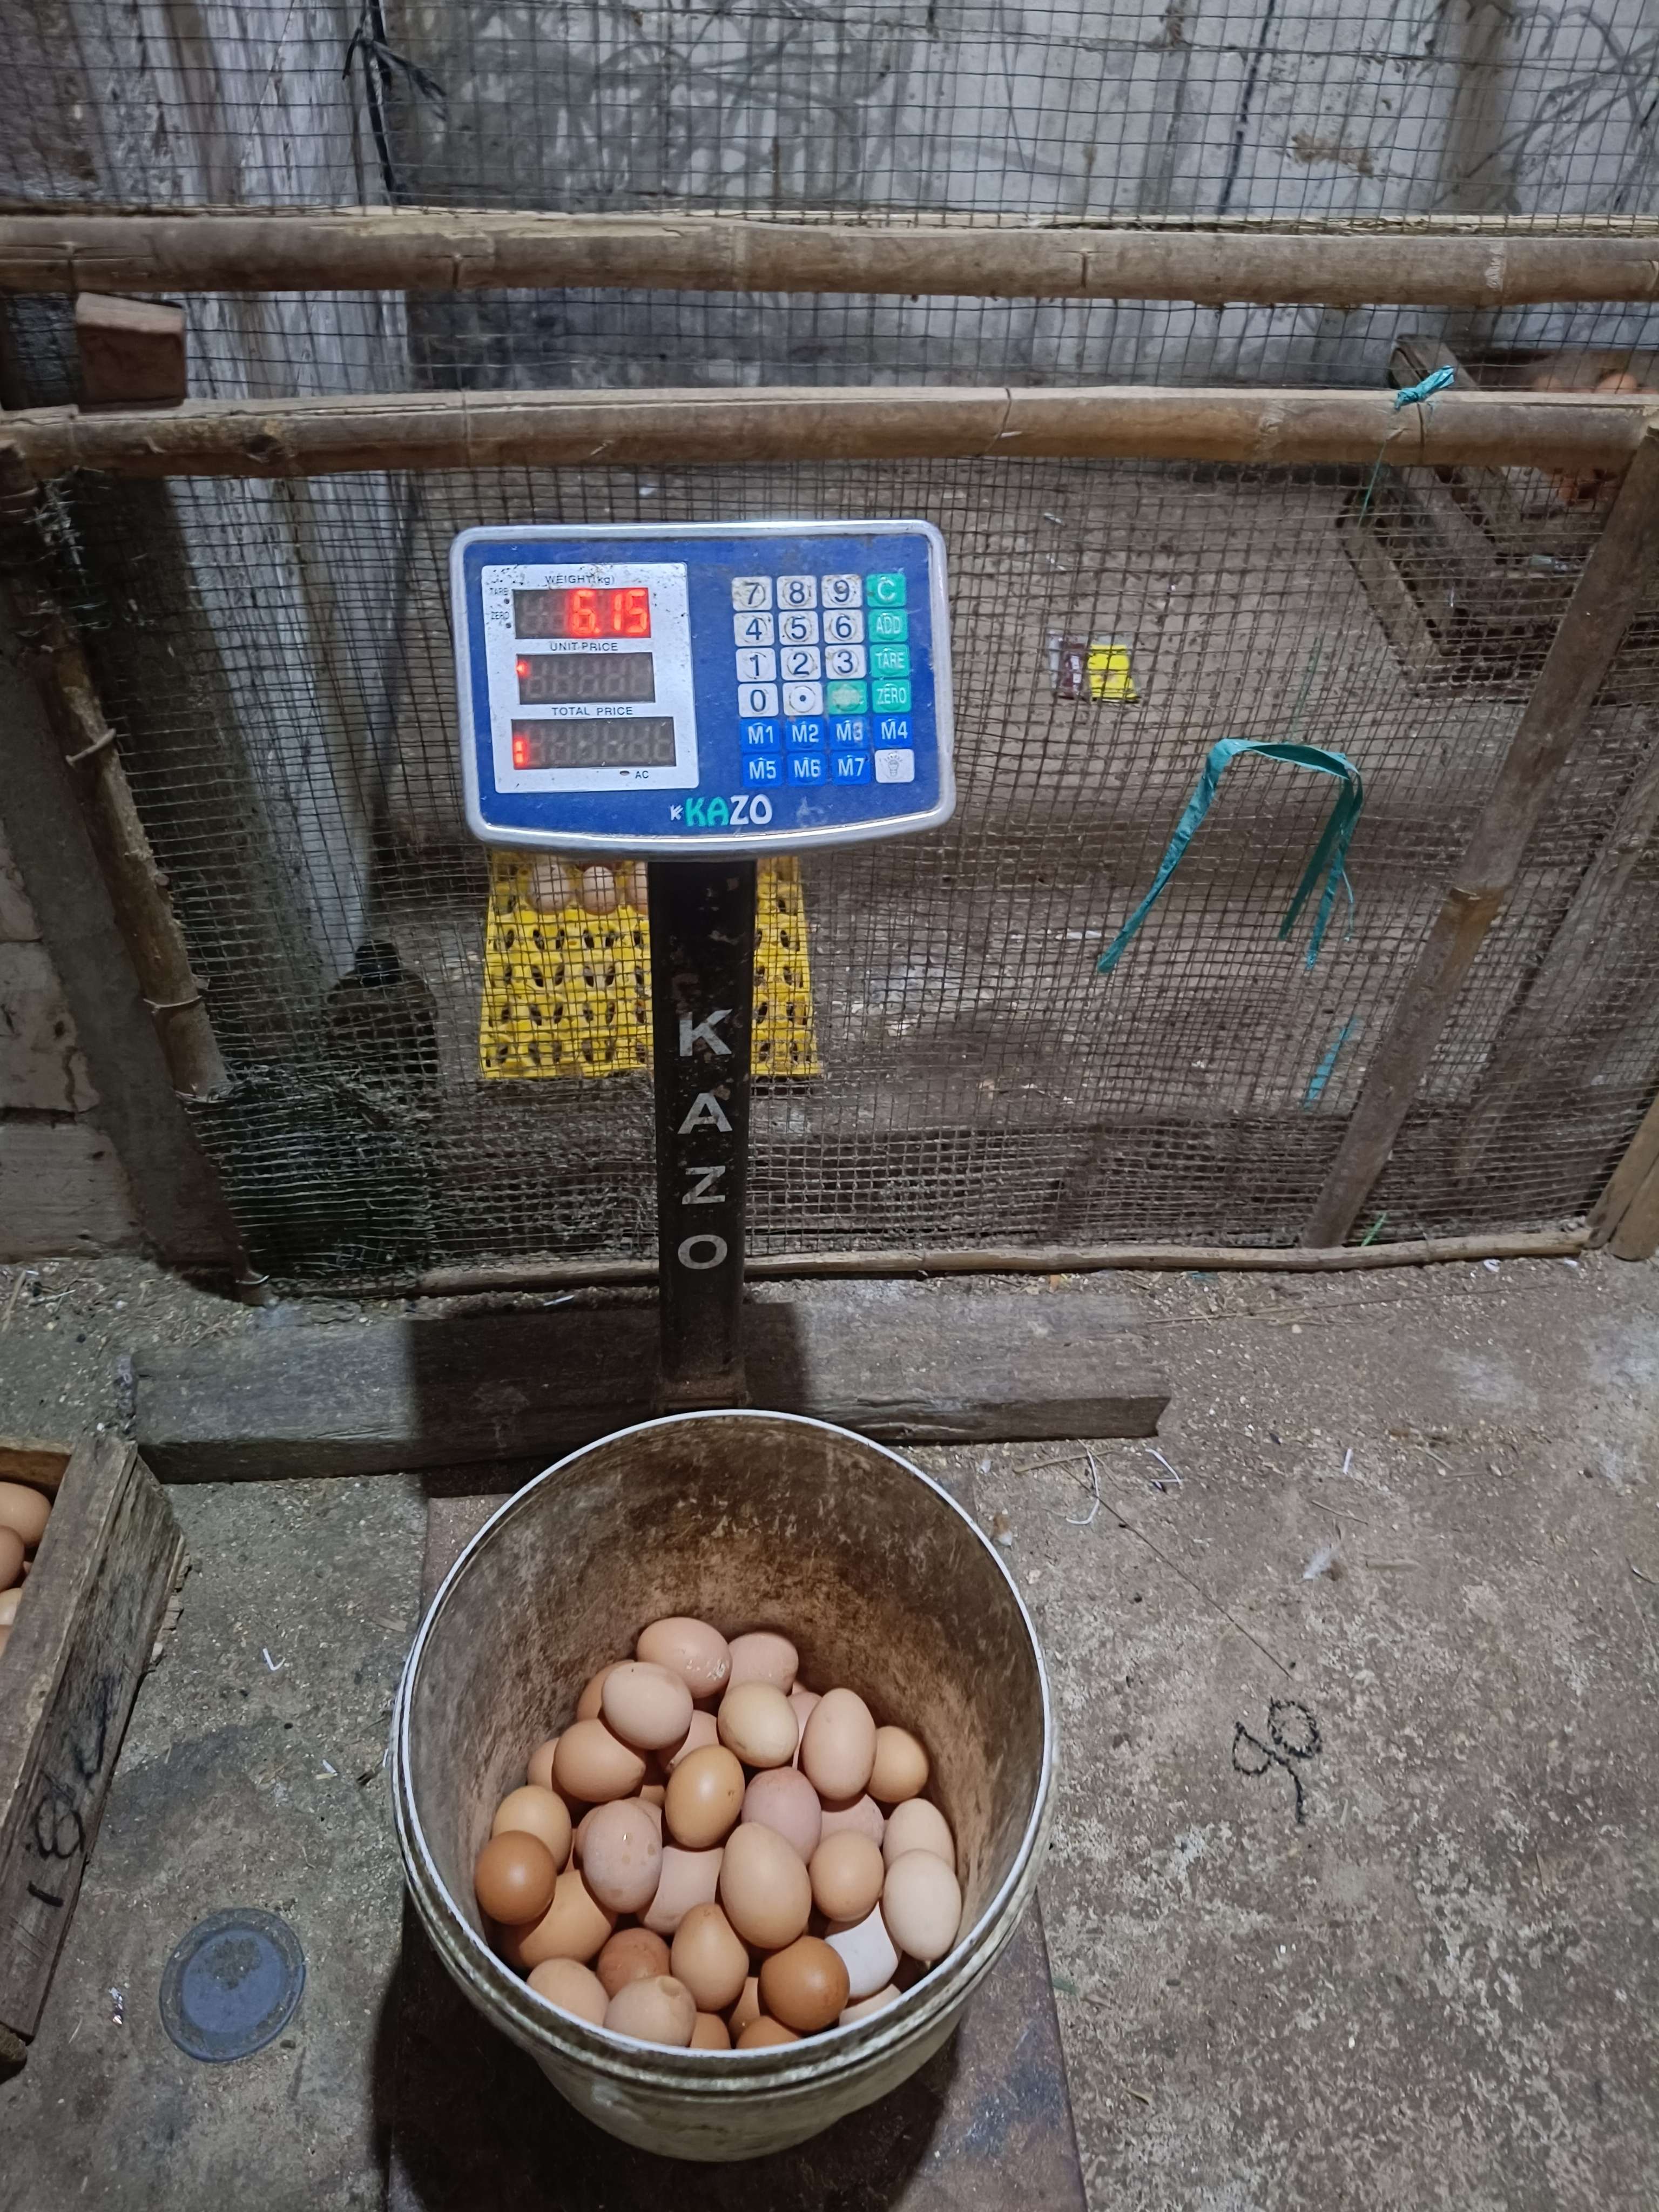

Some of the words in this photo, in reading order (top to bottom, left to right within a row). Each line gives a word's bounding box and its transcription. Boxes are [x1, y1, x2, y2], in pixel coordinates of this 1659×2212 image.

[747, 582, 759, 605] 7
[790, 581, 805, 605] 8
[834, 579, 849, 603] 9
[877, 578, 895, 601] C
[572, 589, 648, 634] 6.15
[745, 618, 763, 640] 4
[791, 616, 807, 640] 5
[835, 615, 852, 638] 6
[875, 618, 901, 635] ADD
[550, 642, 579, 651] UNIT
[582, 642, 618, 651] PRICE
[750, 654, 759, 677] 1
[793, 652, 809, 676] 2
[838, 651, 853, 674] 3
[875, 652, 905, 669] TARE
[750, 689, 766, 712] 0
[876, 687, 907, 705] ZERO
[551, 707, 590, 716] TOTAL
[596, 706, 633, 716] PRICE
[748, 727, 774, 744] M1
[792, 726, 819, 743] M2
[881, 720, 908, 740] M4
[635, 771, 649, 779] AC
[749, 761, 777, 779] M5
[794, 759, 821, 778] M6
[838, 758, 865, 777] M7
[685, 794, 773, 827] KAZO
